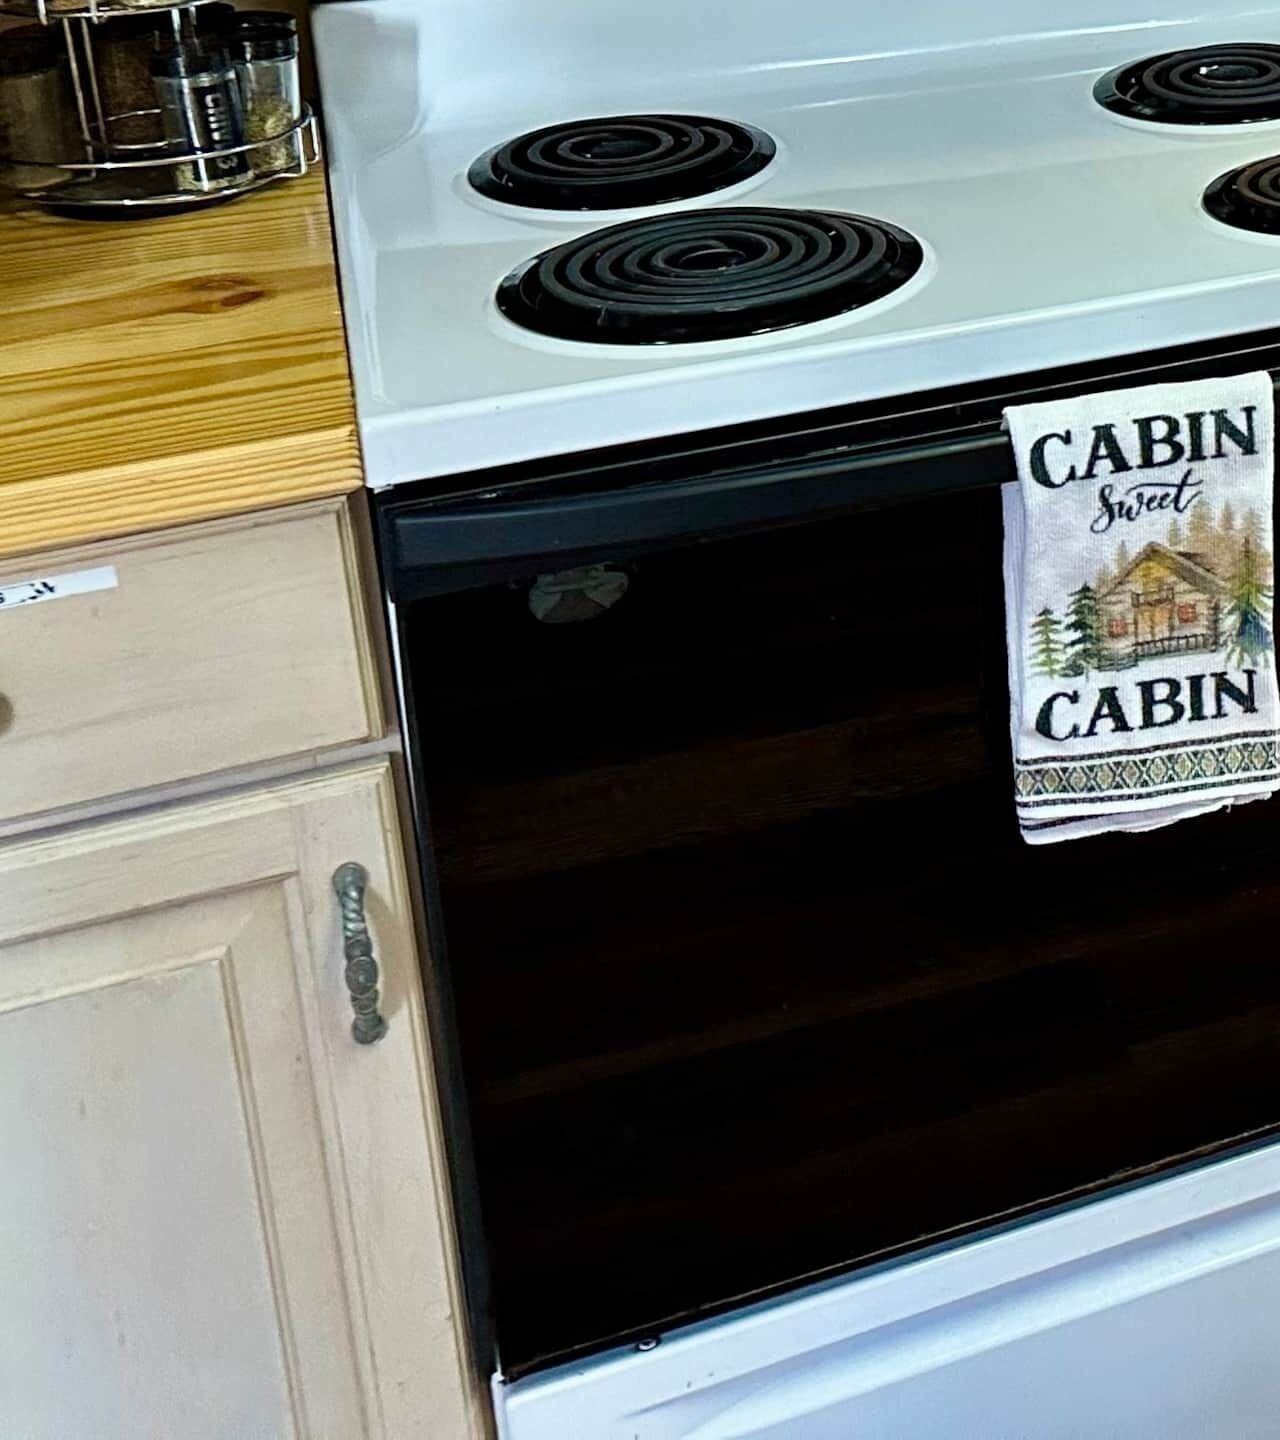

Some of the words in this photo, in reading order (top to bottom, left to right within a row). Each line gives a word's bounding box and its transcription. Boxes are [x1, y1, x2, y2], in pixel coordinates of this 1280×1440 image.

[1030, 406, 1259, 488] CABIN
[1090, 468, 1204, 534] Sweet
[1035, 669, 1259, 742] CABIN
